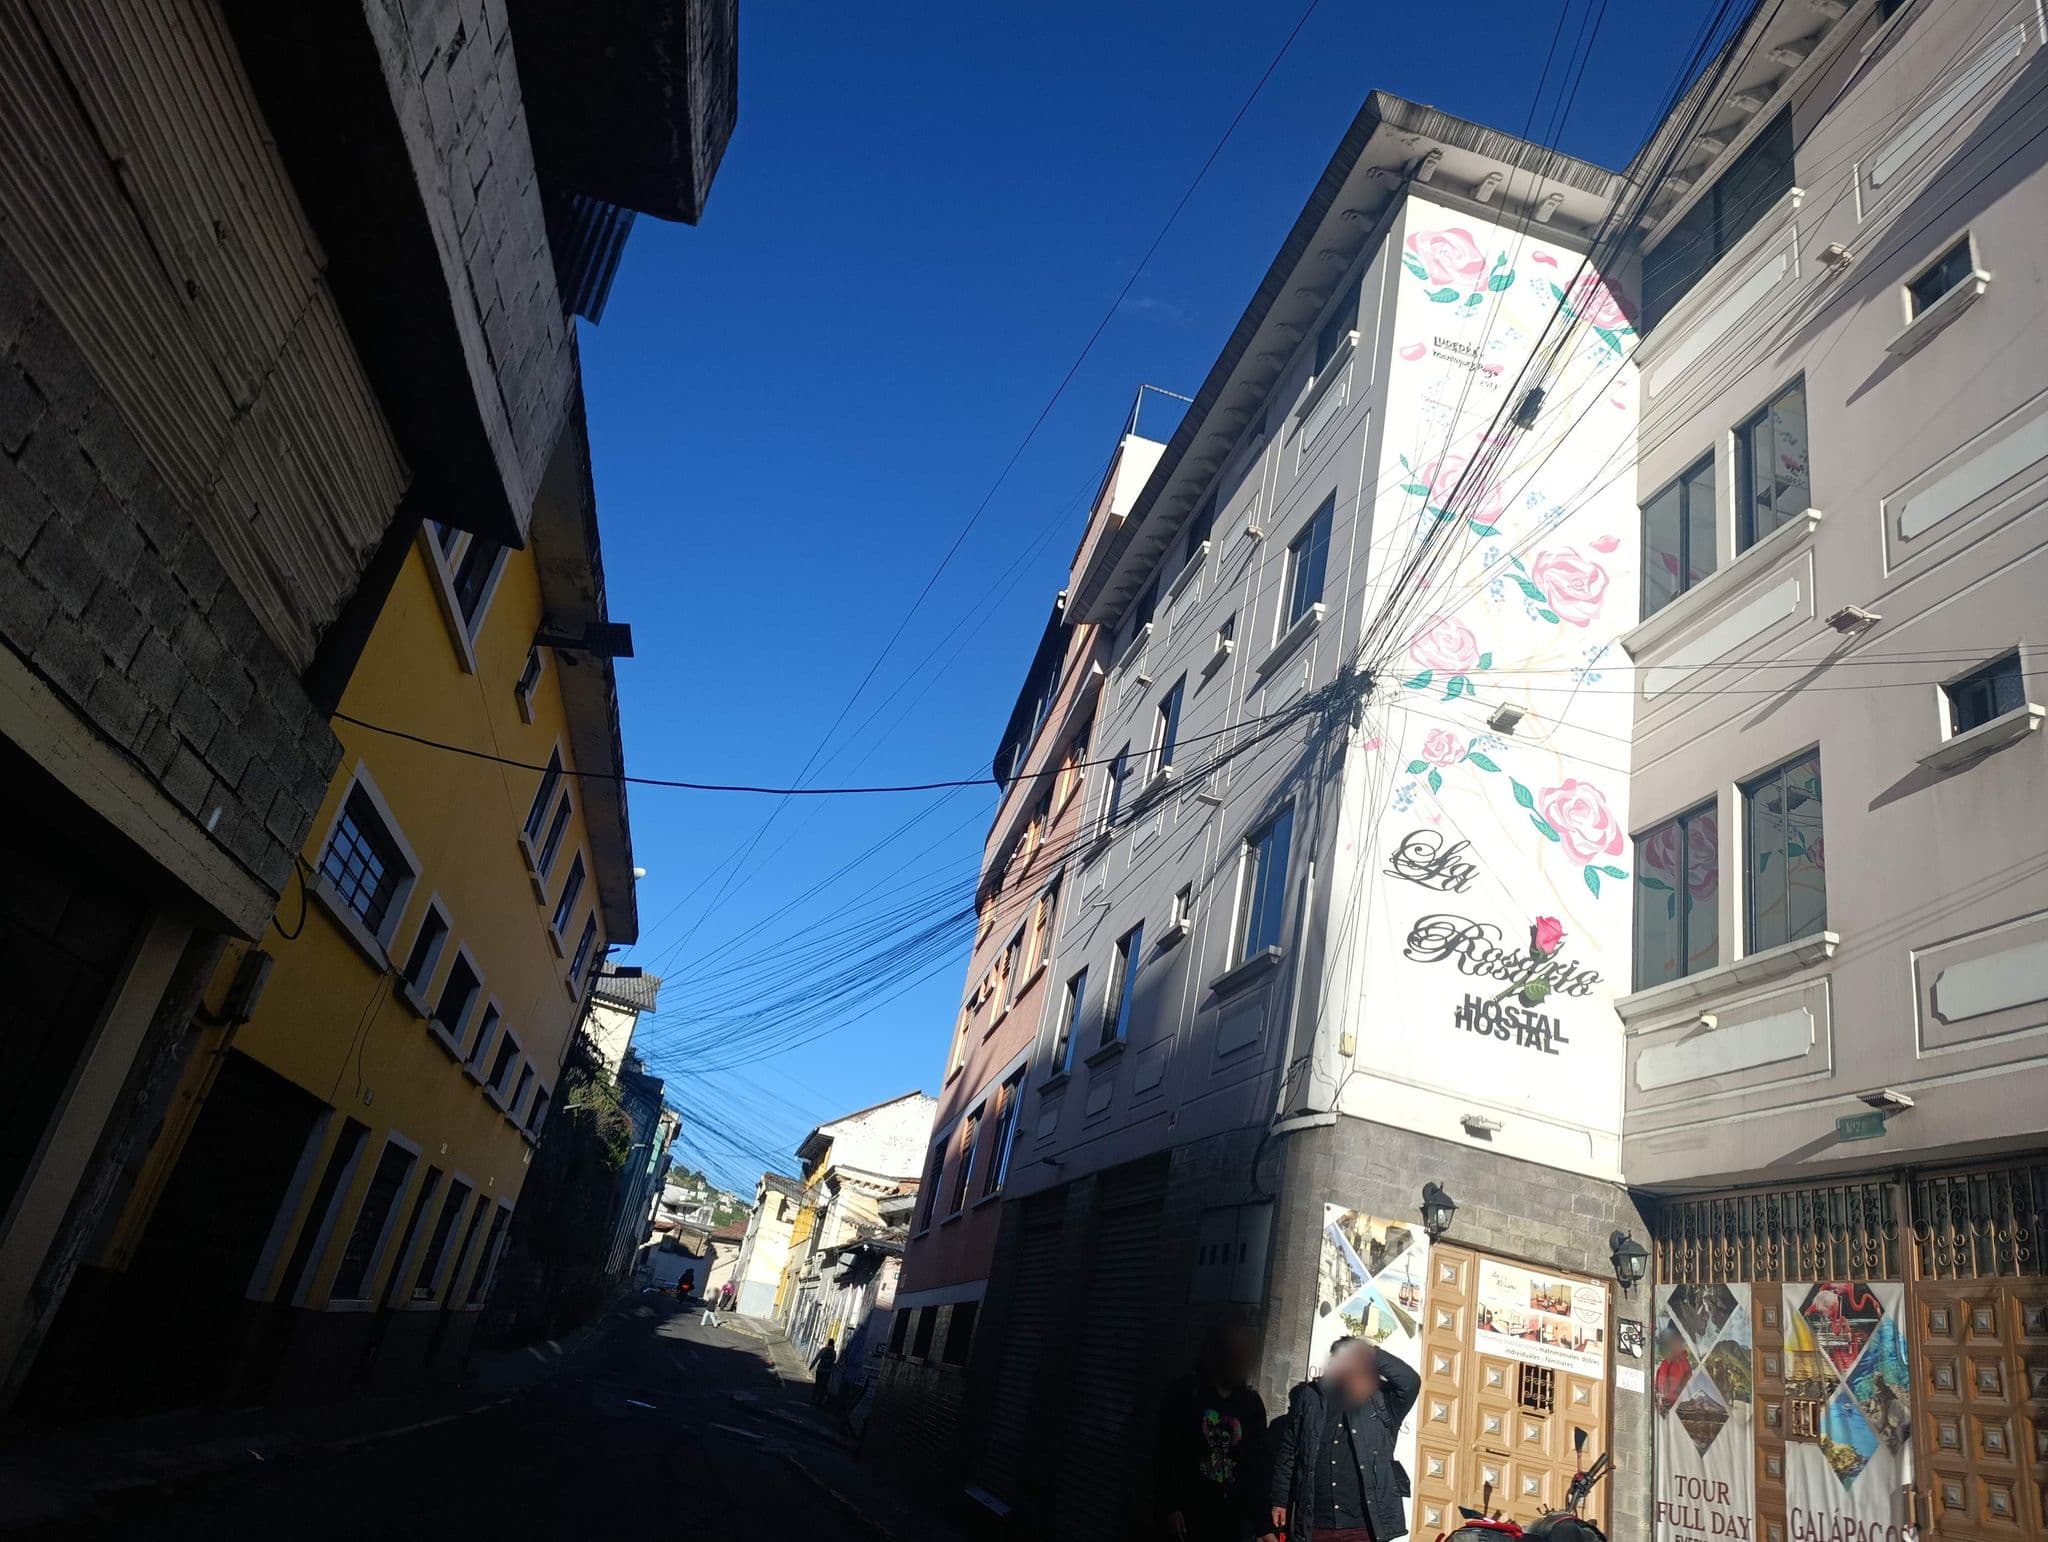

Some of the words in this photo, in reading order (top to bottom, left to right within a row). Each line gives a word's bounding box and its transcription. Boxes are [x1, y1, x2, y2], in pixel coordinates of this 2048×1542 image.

[1384, 829, 1480, 892] La
[1456, 993, 1569, 1052] HOSTAL
[1675, 1475, 1731, 1506] TOUR
[1657, 1501, 1705, 1531] FULL
[1711, 1511, 1752, 1540] DAY
